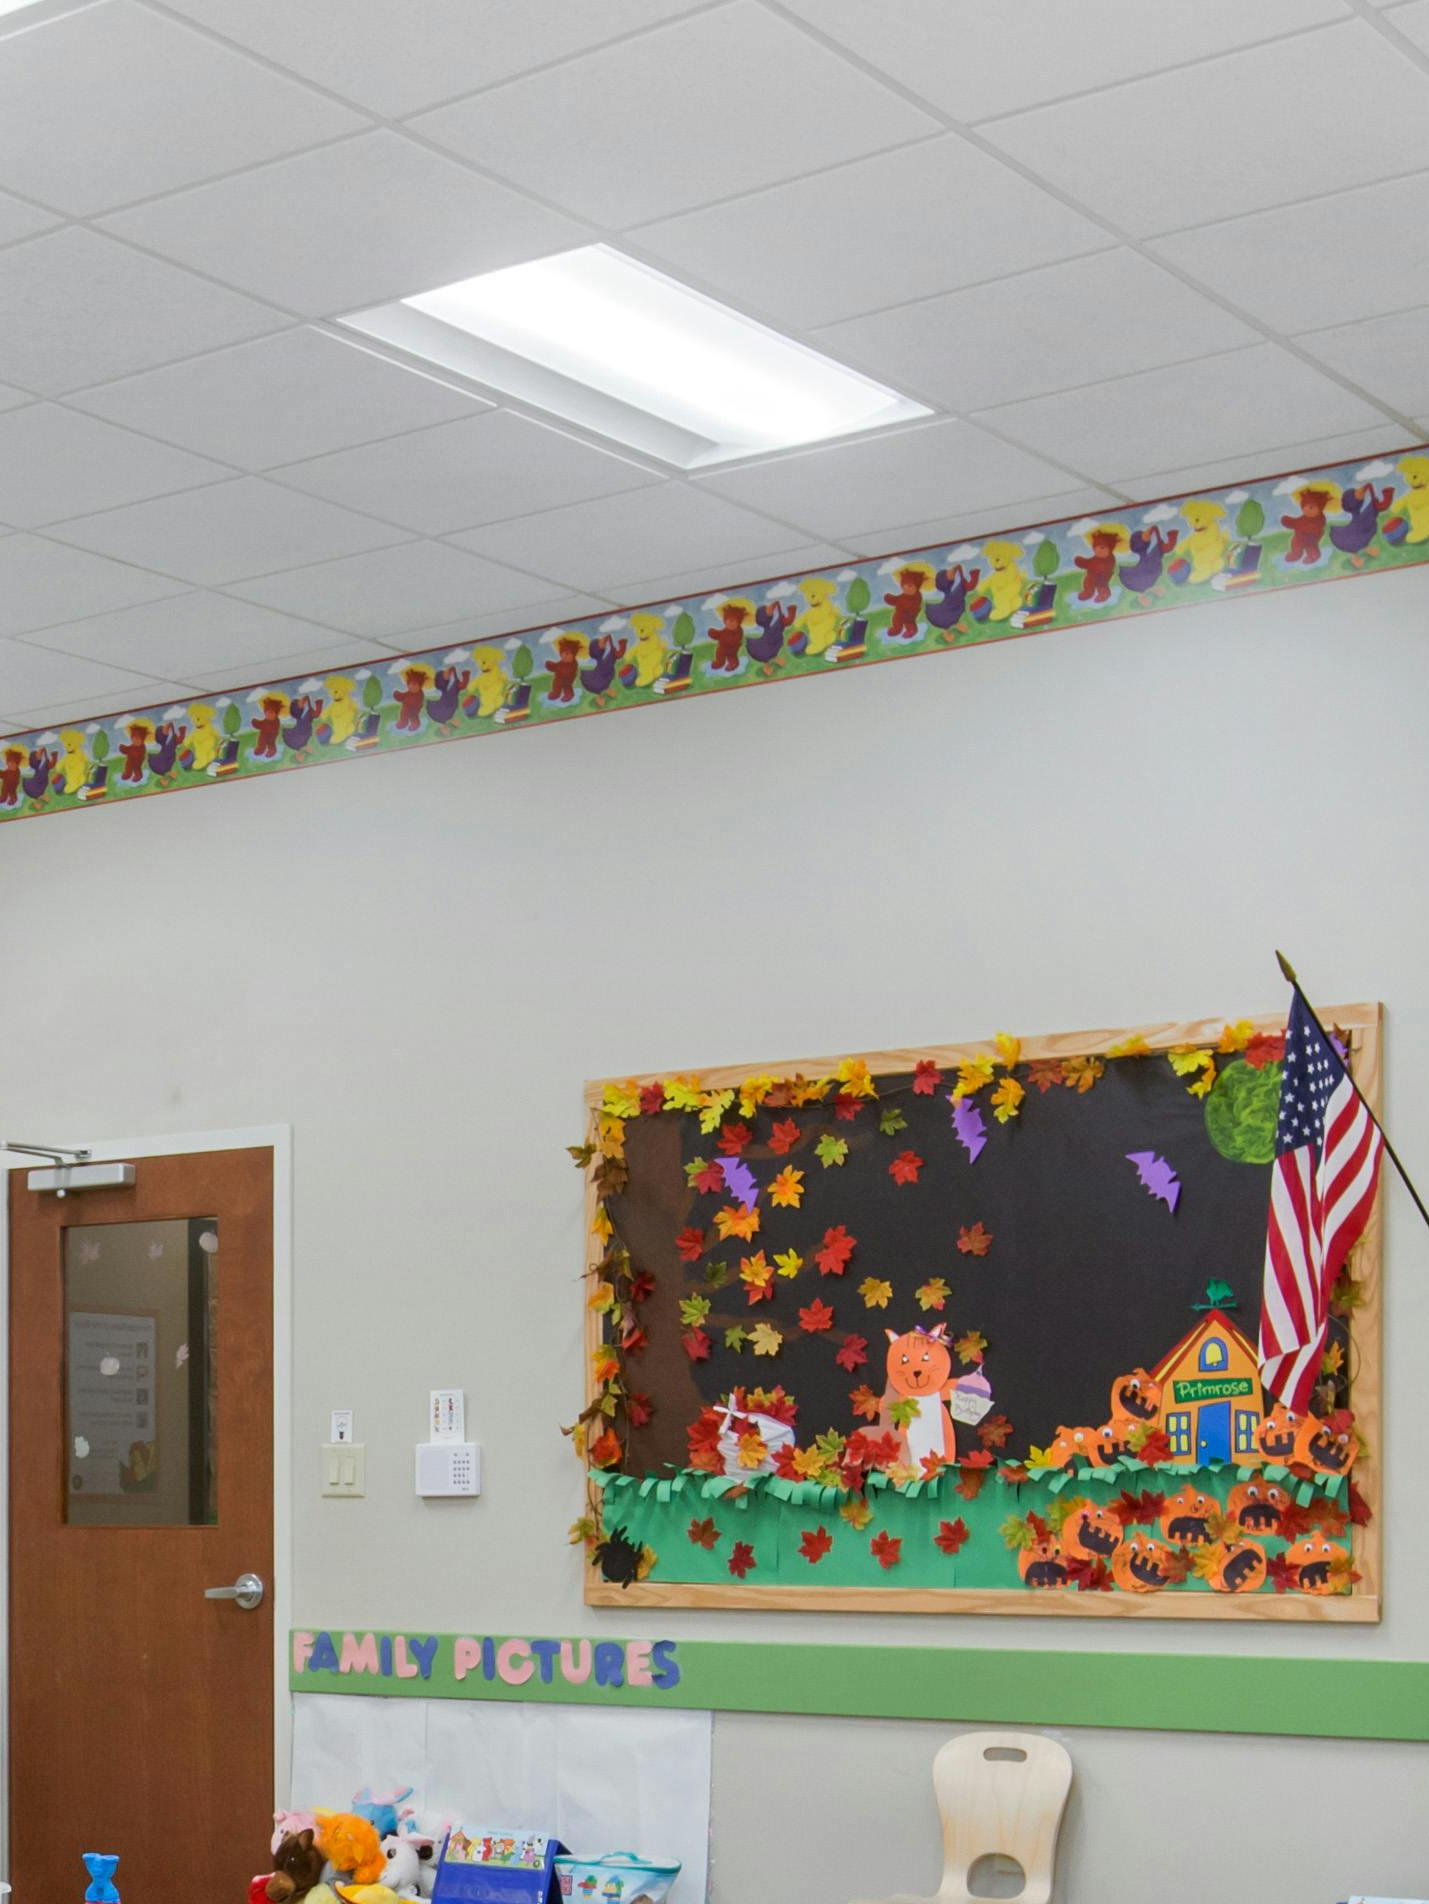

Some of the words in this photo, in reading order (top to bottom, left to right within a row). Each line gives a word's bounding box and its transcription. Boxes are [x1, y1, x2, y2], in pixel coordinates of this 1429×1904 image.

[1175, 1380, 1249, 1398] Primrose
[292, 1631, 439, 1680] FAMILY
[453, 1635, 682, 1690] PICTURES
